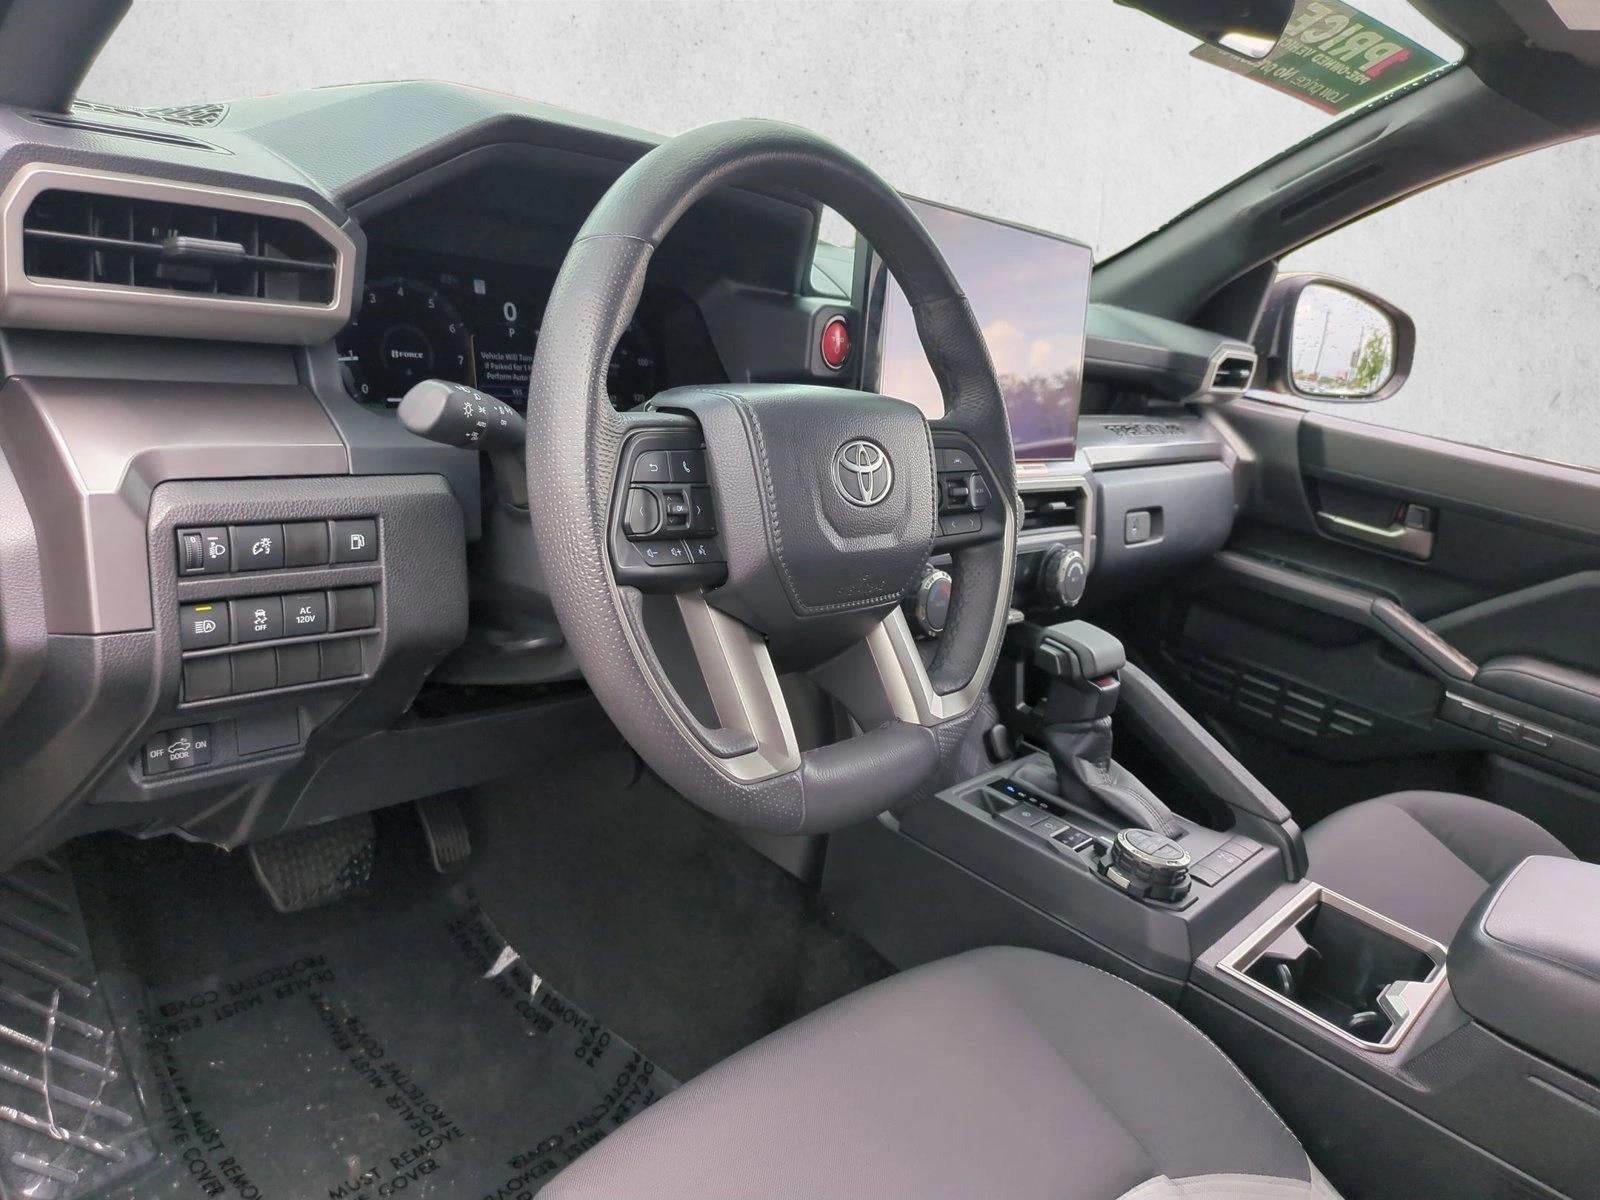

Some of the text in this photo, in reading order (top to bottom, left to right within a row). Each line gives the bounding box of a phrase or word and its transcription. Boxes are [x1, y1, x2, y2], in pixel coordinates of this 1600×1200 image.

[370, 292, 377, 303] 3
[503, 302, 518, 321] 0
[449, 324, 456, 334] 6
[509, 328, 516, 338] P
[458, 354, 465, 365] 7
[300, 606, 312, 615] AC
[296, 615, 316, 624] 120V
[195, 740, 207, 749] ON
[150, 749, 164, 758] OFF
[169, 752, 189, 761] DOOR
[385, 1093, 435, 1138] DEALER
[190, 1111, 225, 1152] MUST
[218, 1157, 264, 1200] REMO
[328, 1126, 465, 1200] MUST REMOVE
[183, 1147, 226, 1197] COVER
[378, 1158, 440, 1198] COVER
